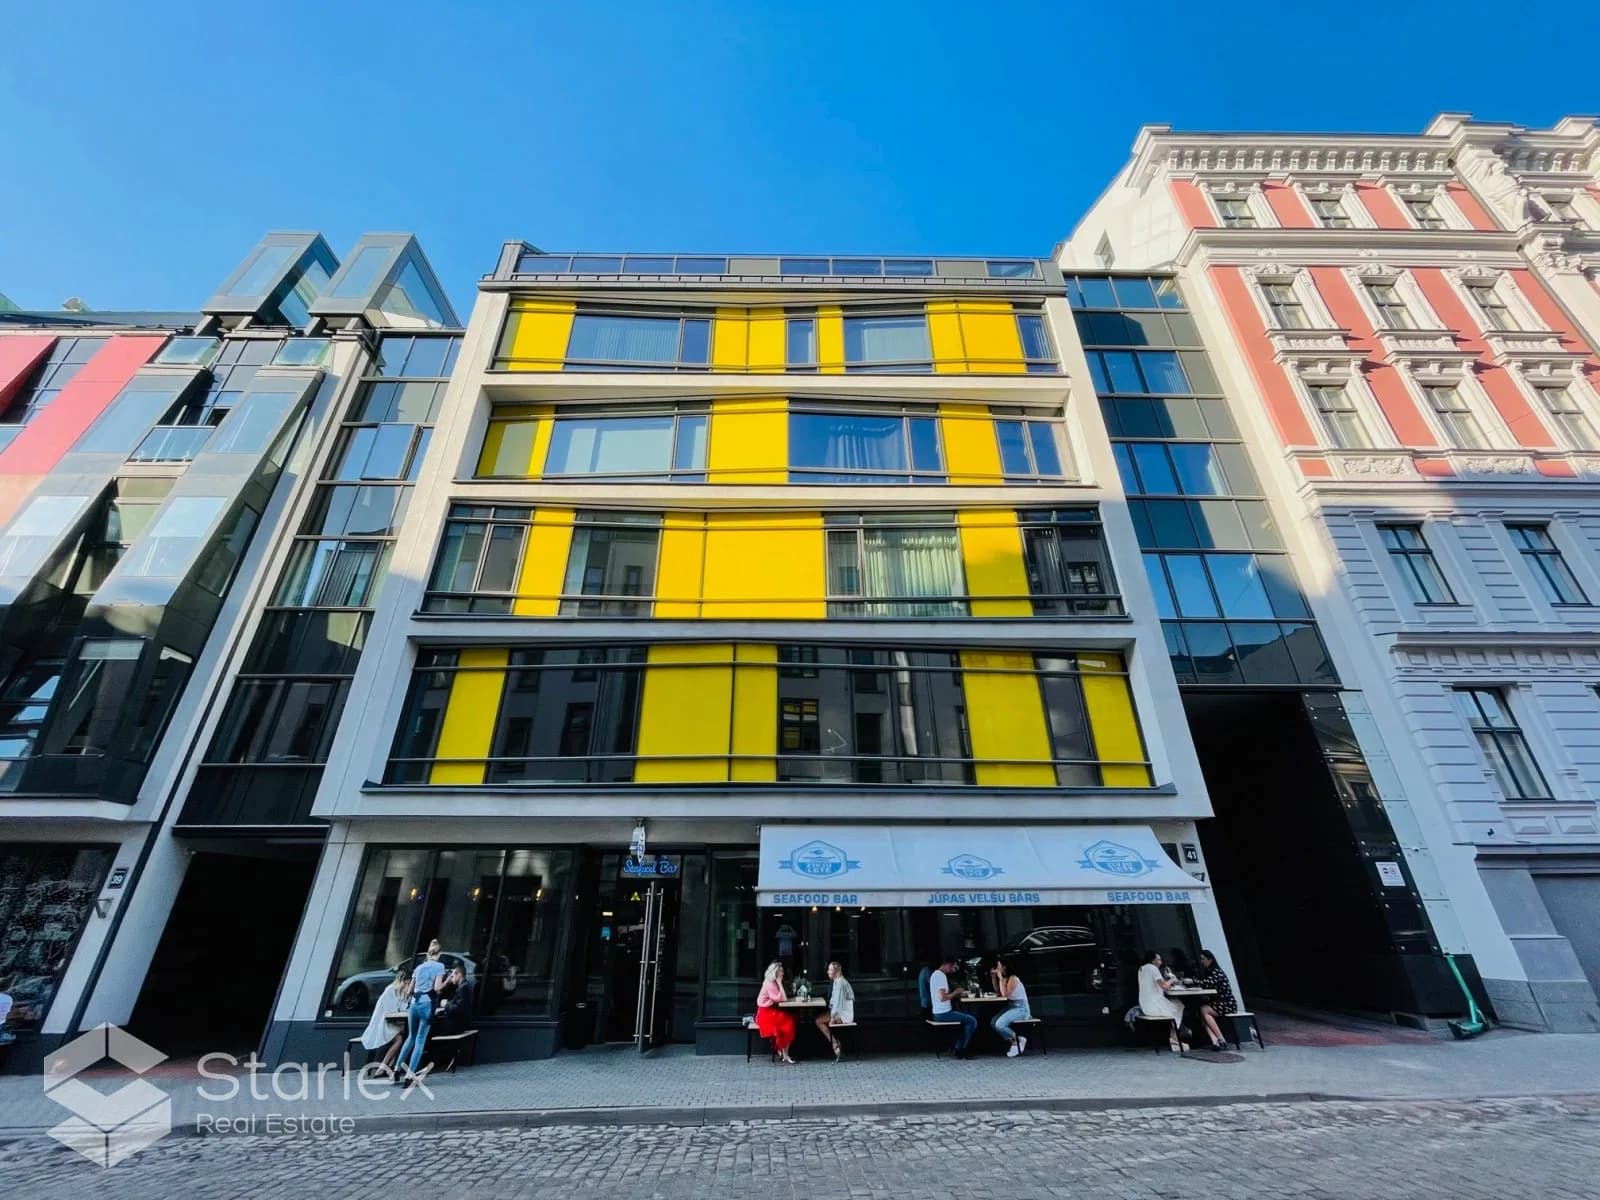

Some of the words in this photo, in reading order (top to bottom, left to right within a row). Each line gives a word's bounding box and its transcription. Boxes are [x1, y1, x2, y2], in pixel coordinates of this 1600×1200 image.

[659, 860, 678, 874] Bar
[772, 893, 830, 905] SEAFOOD
[833, 893, 858, 905] BAR
[1107, 891, 1163, 902] SEAFOOD
[1166, 891, 1191, 901] BAR
